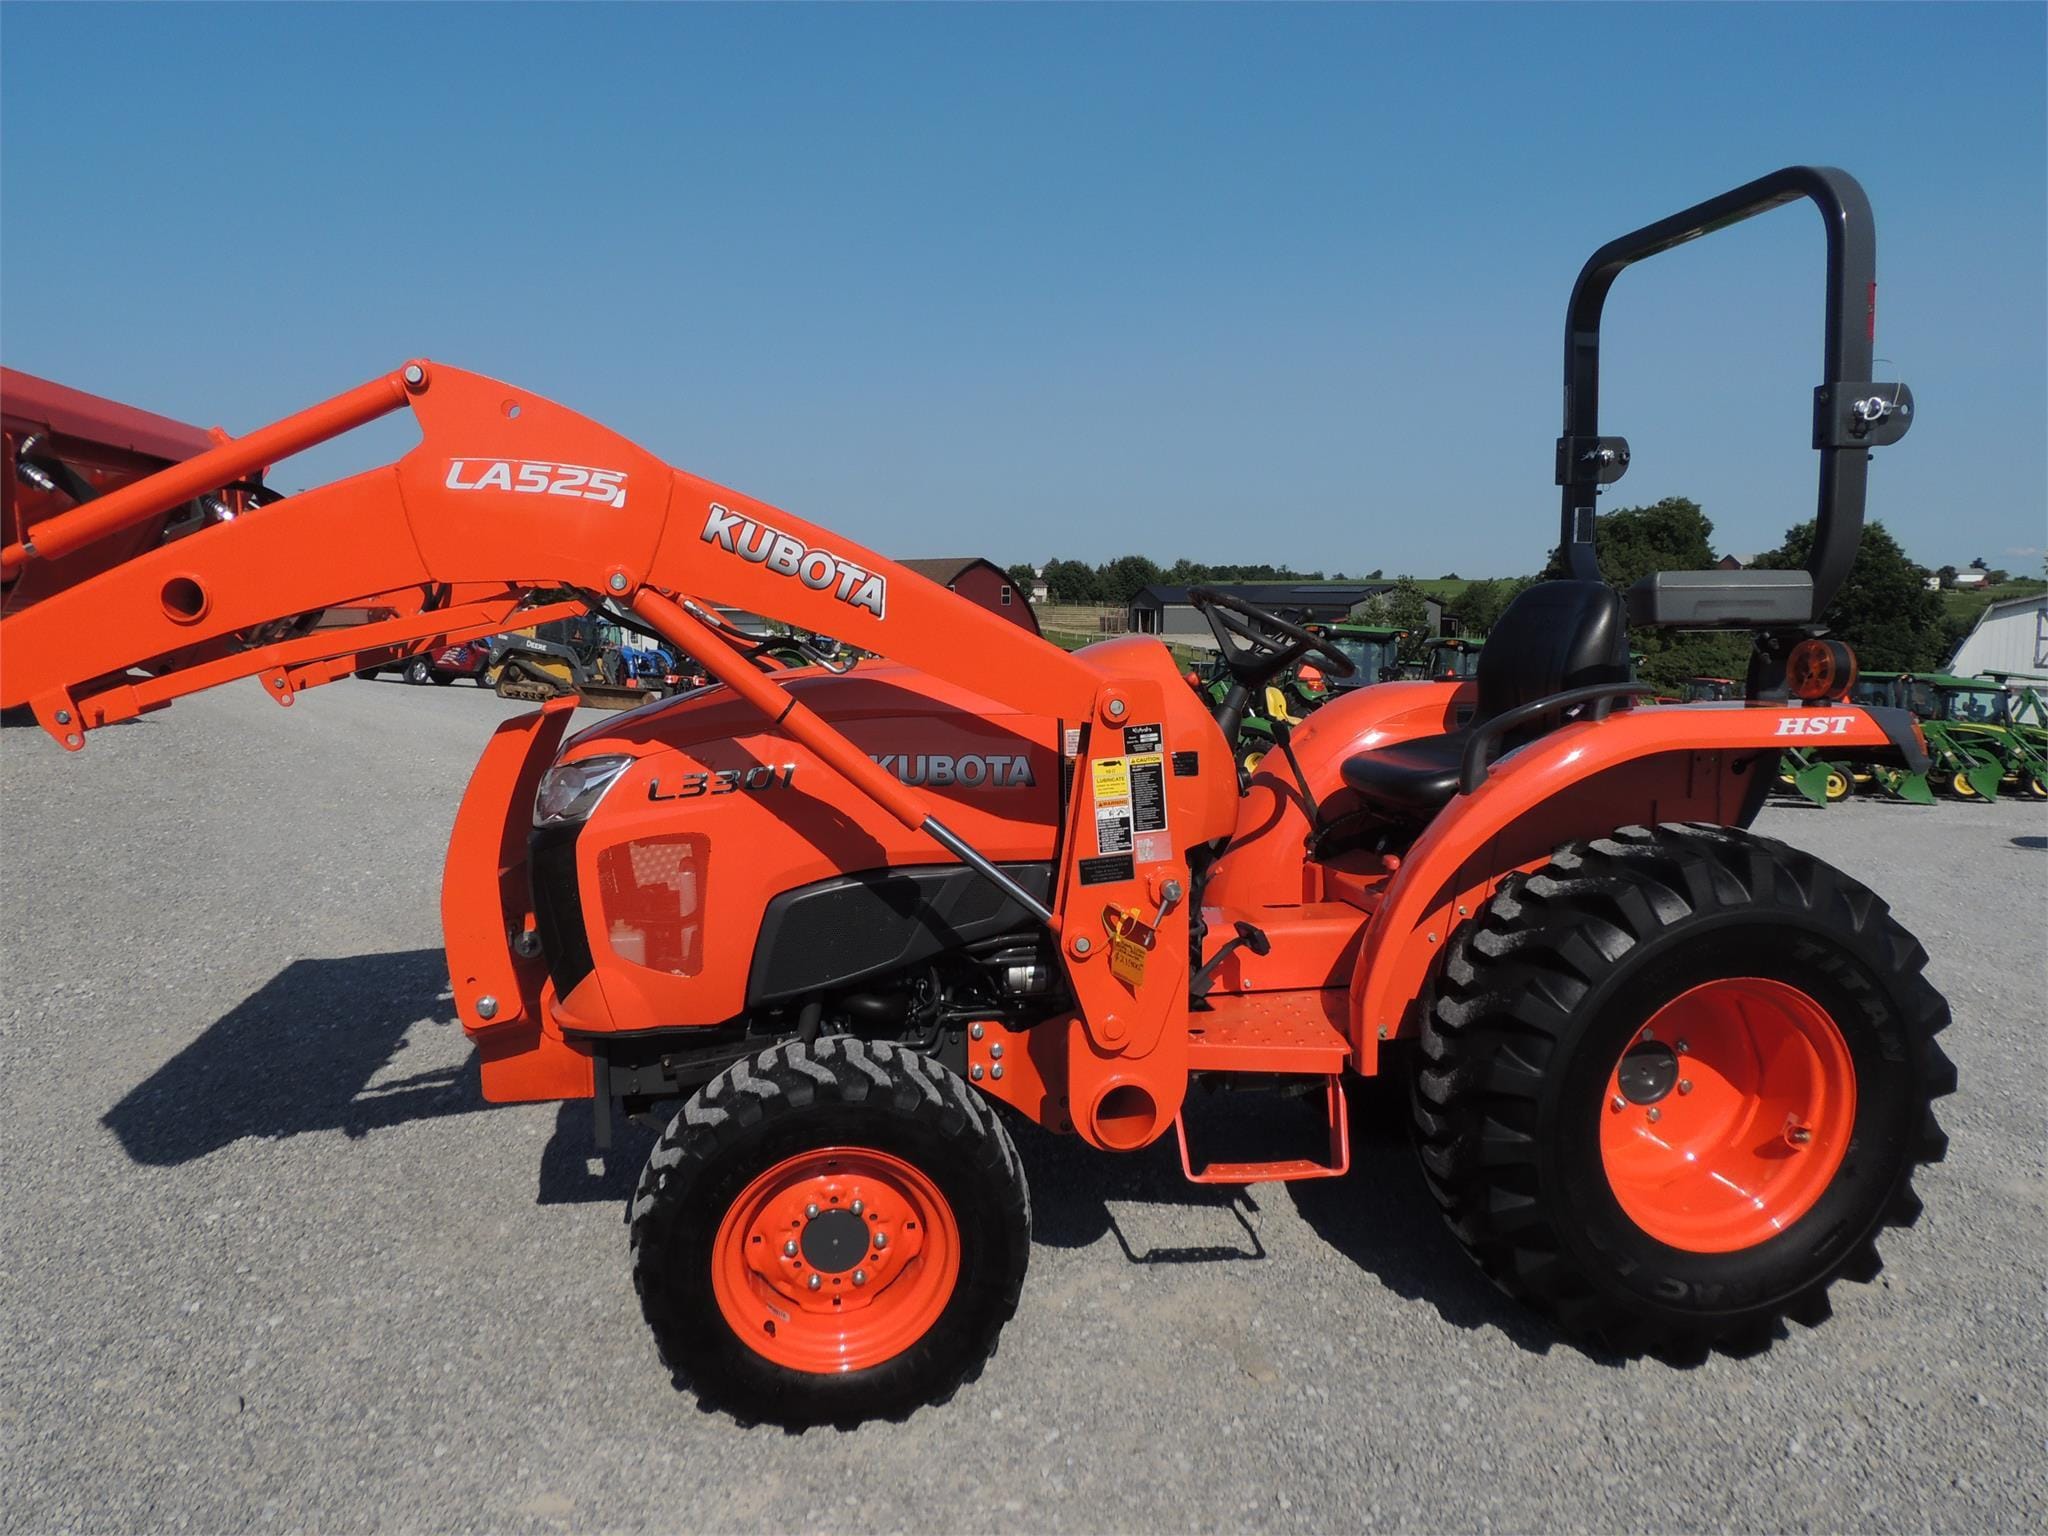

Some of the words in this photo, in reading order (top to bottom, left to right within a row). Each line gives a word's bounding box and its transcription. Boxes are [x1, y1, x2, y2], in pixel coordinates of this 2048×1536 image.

[701, 503, 886, 619] KUBOTA
[526, 639, 547, 651] DEERE
[1774, 716, 1855, 735] HST
[648, 763, 796, 801] L3301
[1792, 937, 1906, 1063] TITAN
